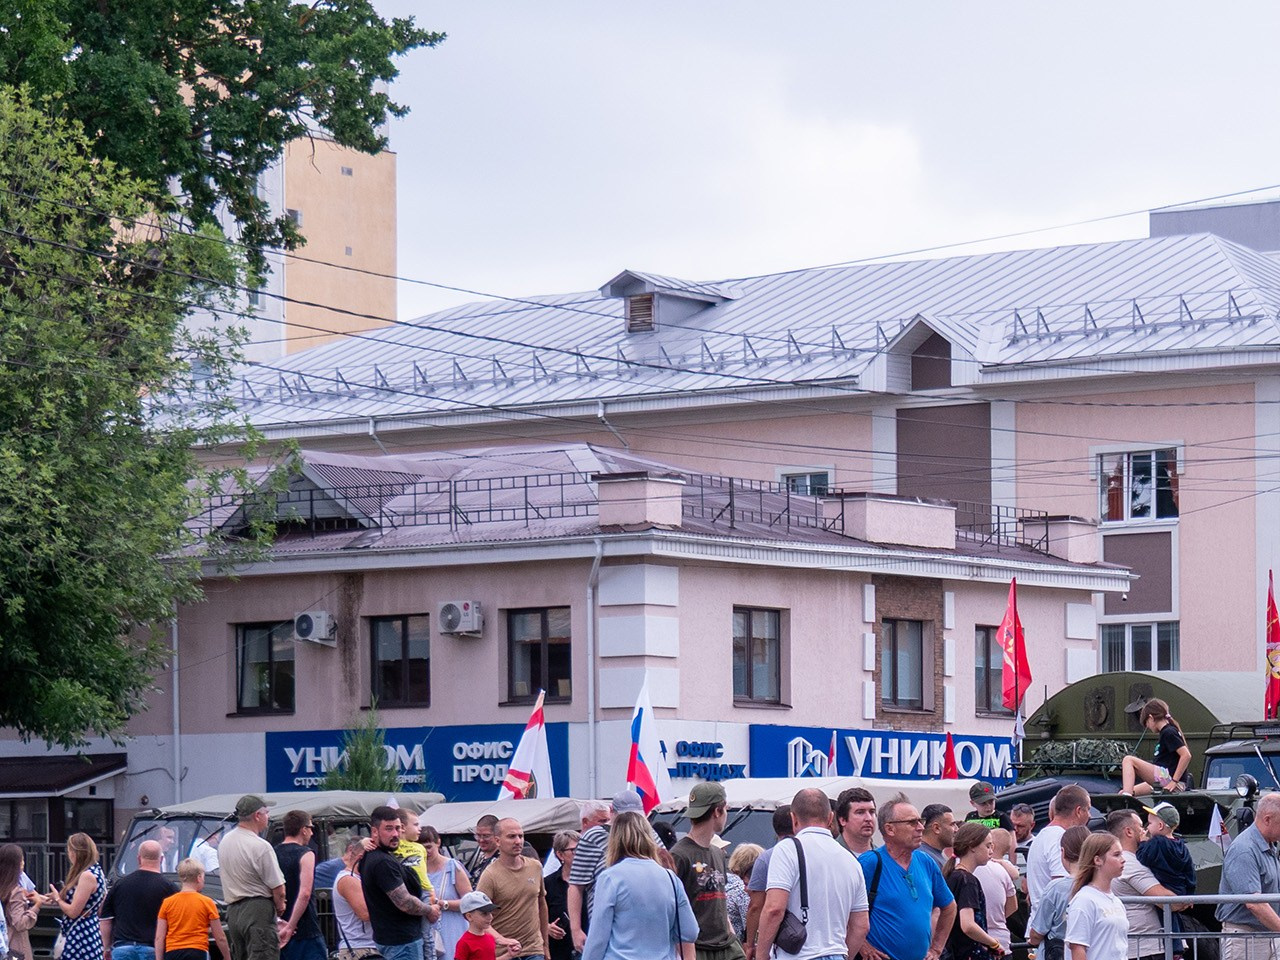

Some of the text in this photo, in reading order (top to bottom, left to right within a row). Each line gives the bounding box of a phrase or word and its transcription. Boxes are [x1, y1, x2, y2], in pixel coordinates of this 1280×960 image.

[284, 744, 426, 774] УНИОМ
[453, 741, 513, 760] ОФИС
[676, 741, 724, 758] ОФИС
[453, 764, 508, 785] ПРОД
[676, 762, 746, 782] ПРОДАЖ
